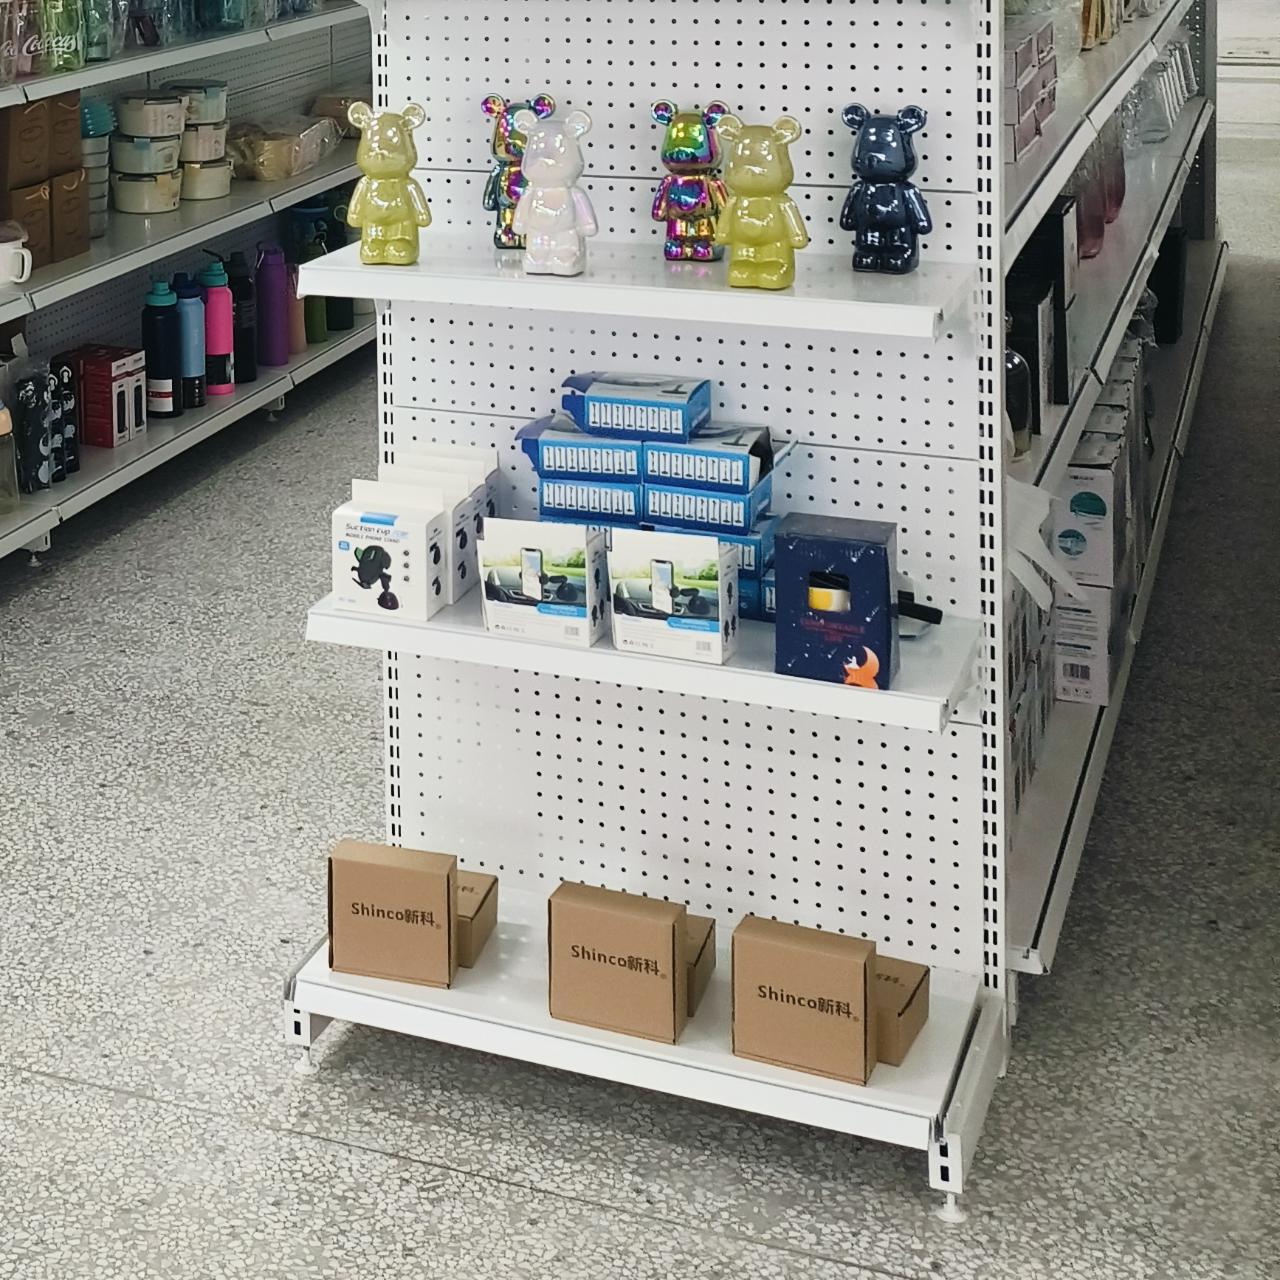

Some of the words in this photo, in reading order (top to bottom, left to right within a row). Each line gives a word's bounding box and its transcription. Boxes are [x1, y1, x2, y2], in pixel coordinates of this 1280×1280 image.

[350, 901, 436, 927] Shinco新科
[570, 944, 660, 976] Shinco新科
[757, 984, 852, 1019] Shinco新科
